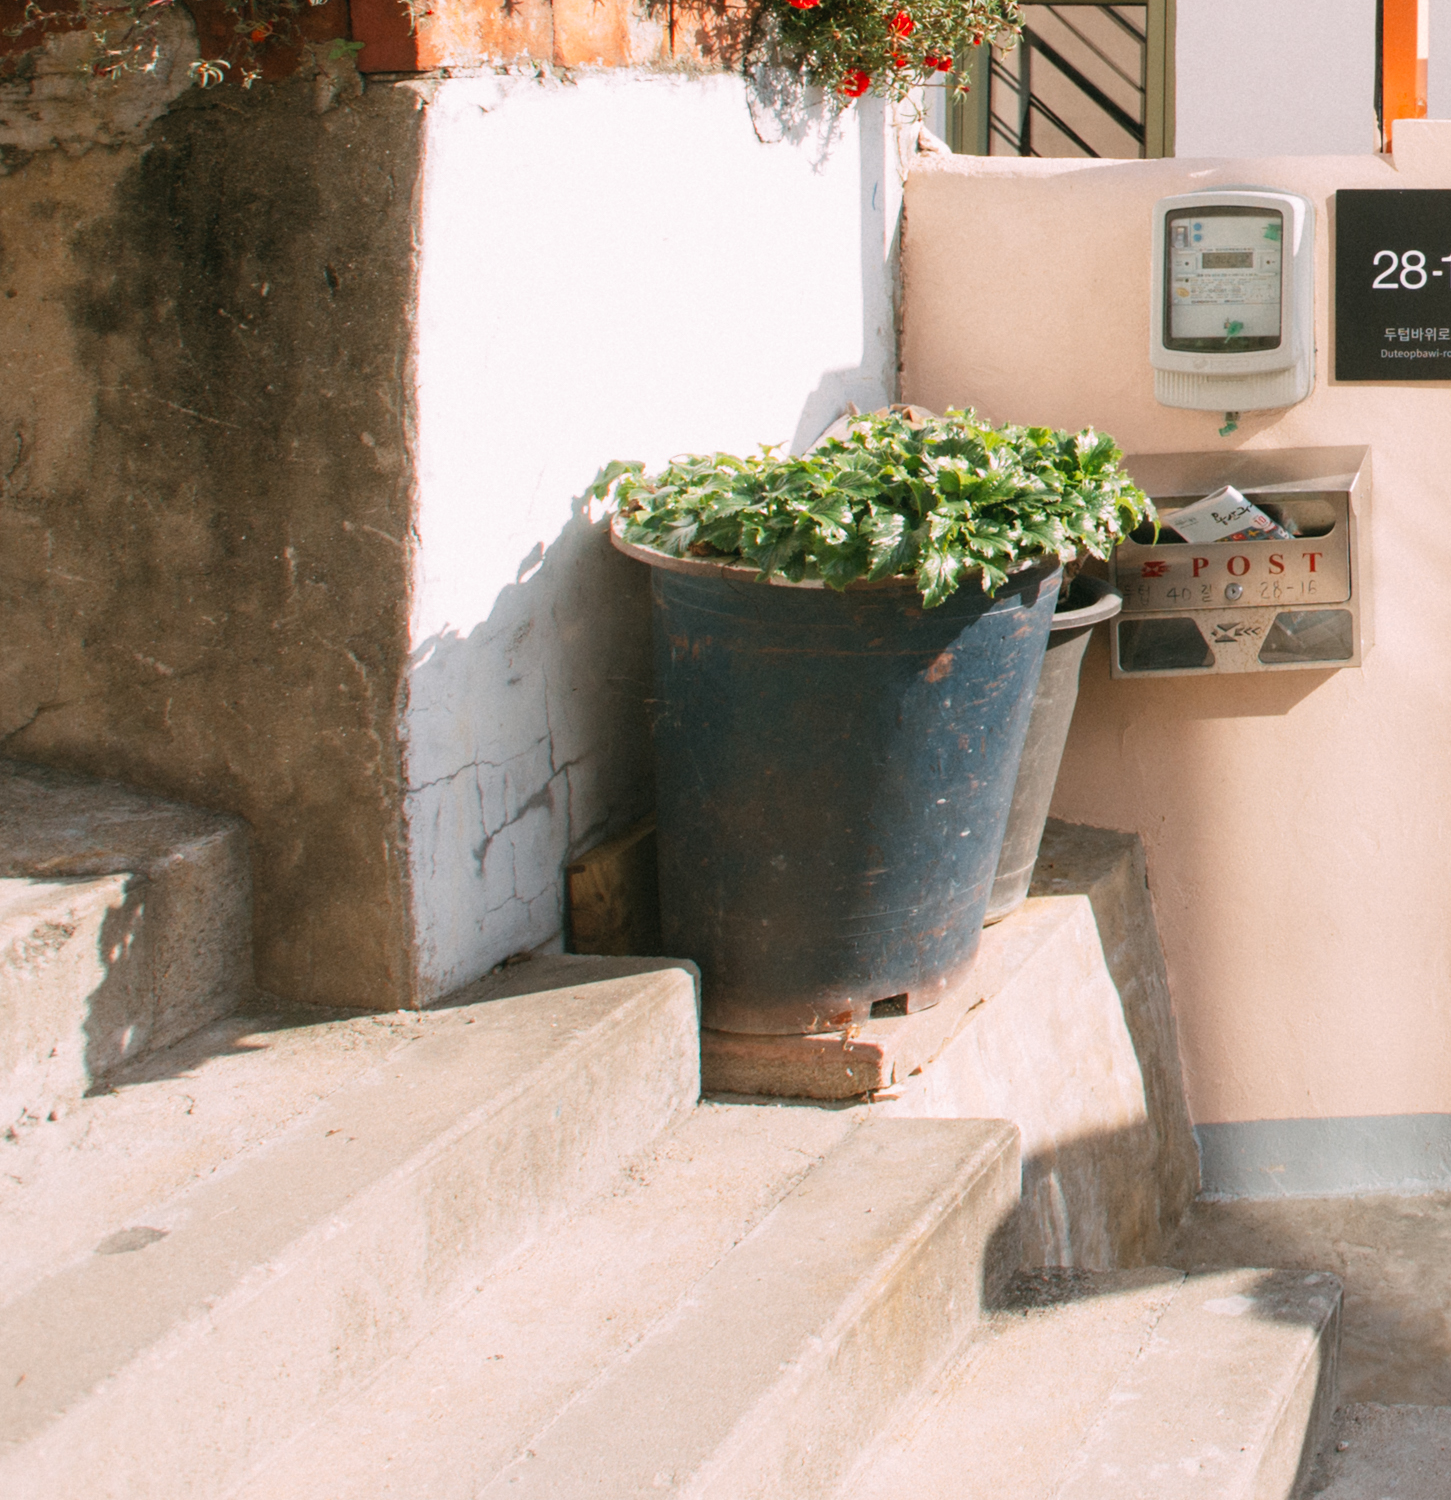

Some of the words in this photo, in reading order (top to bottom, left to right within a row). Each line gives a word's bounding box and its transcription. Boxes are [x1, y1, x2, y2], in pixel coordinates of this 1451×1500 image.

[1192, 552, 1323, 578] POST
[1166, 587, 1192, 601] 40
[1200, 584, 1213, 603] 길
[1260, 580, 1318, 601] 28-16
